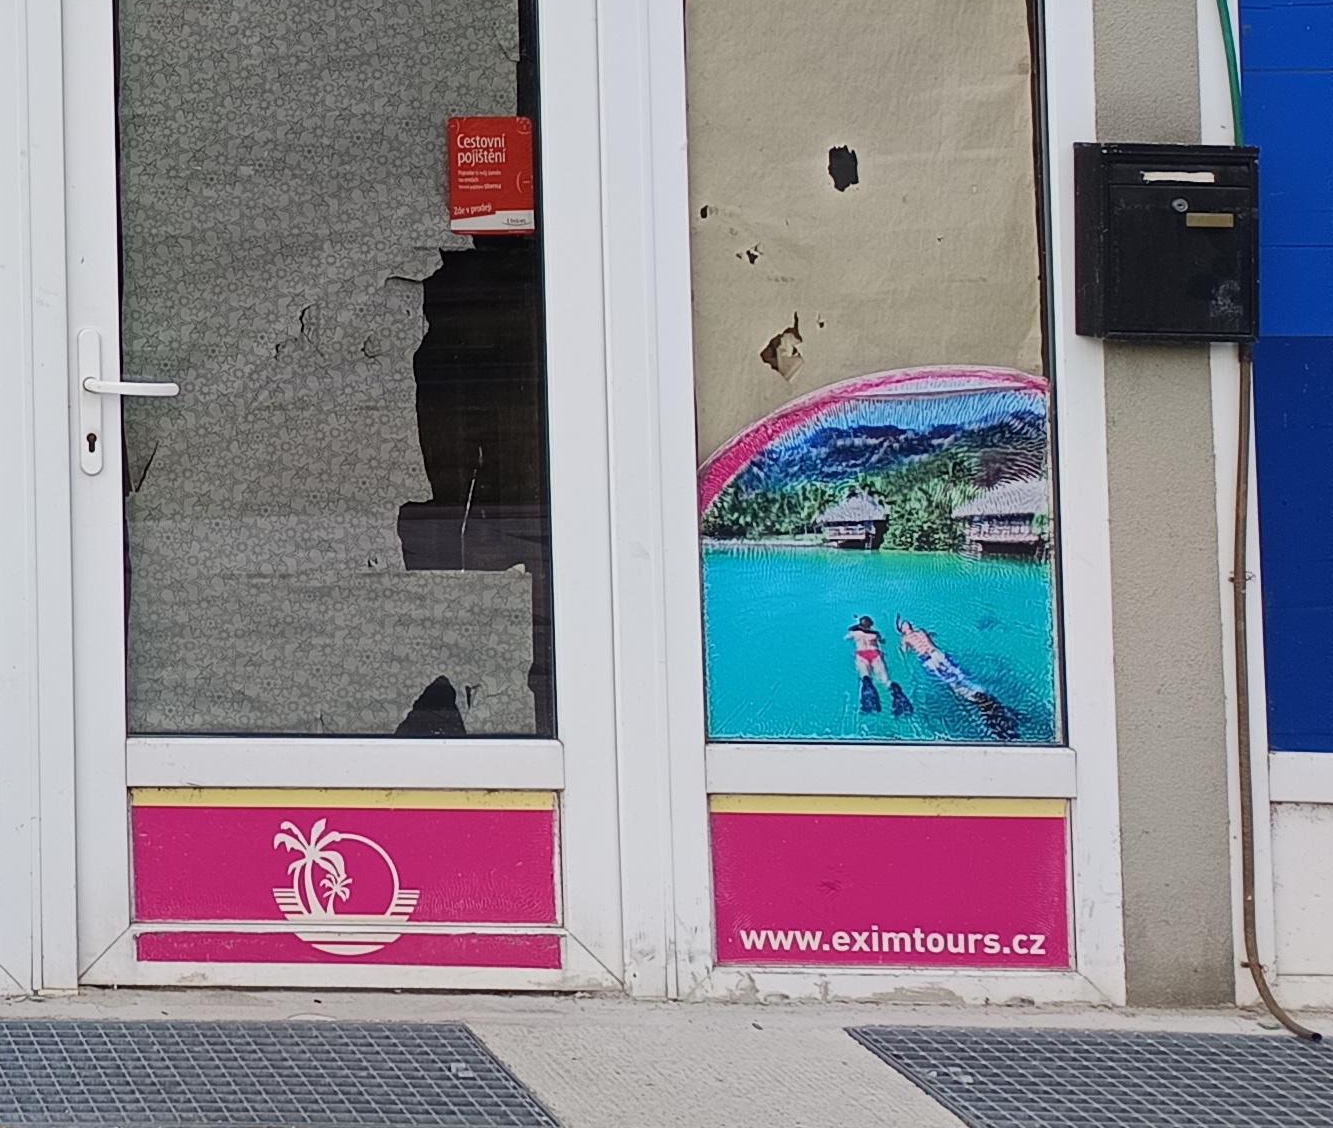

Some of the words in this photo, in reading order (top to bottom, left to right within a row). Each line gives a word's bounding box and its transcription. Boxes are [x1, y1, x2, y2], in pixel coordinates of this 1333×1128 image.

[456, 133, 505, 149] Cestovní
[457, 148, 506, 167] pojištění
[740, 924, 1046, 956] www.eximtours.cz
